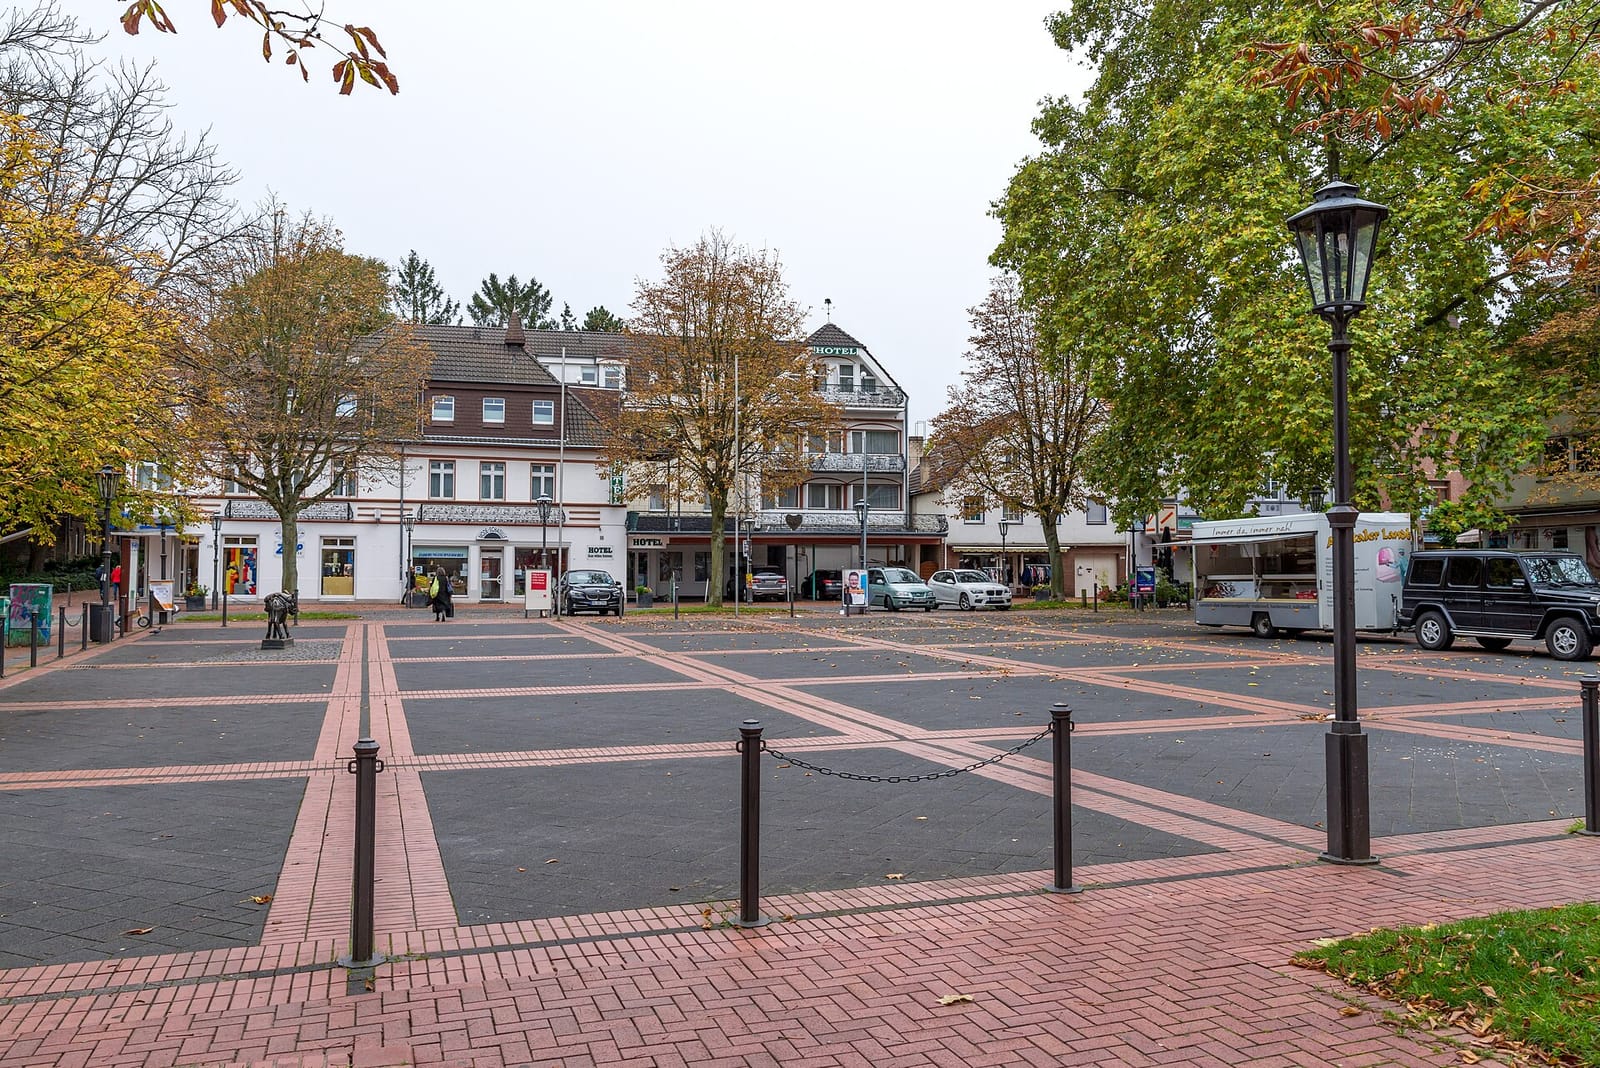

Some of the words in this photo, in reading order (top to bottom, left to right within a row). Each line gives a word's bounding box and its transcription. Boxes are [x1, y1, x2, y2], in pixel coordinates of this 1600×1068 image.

[816, 347, 857, 355] HOTEL
[1212, 528, 1234, 536] Immer
[1236, 526, 1248, 535] da,
[1275, 521, 1294, 532] nah!
[632, 538, 663, 546] HOTEL
